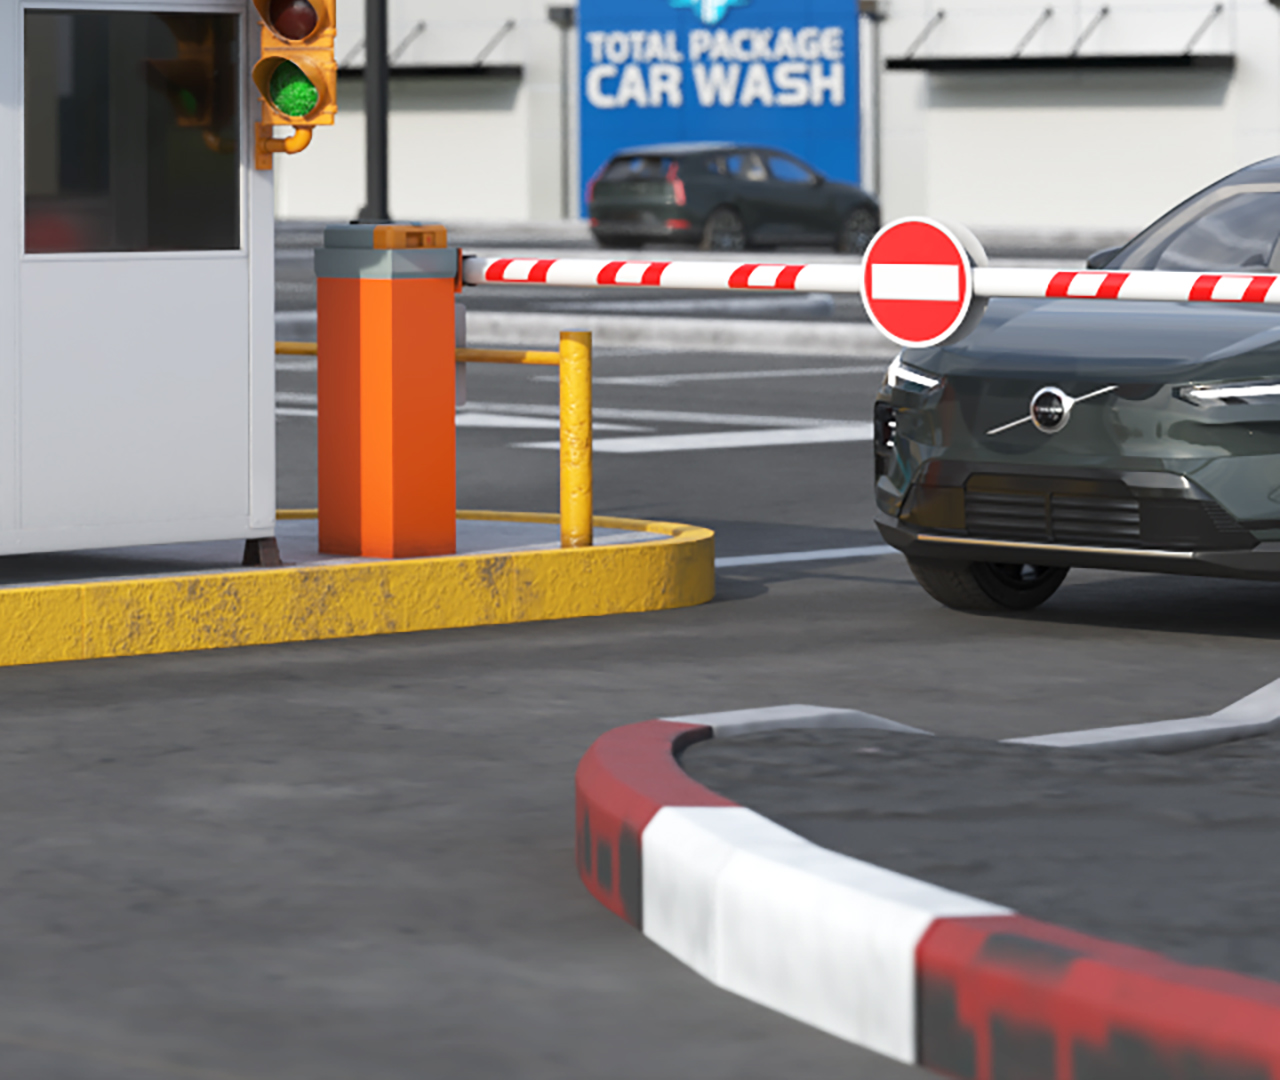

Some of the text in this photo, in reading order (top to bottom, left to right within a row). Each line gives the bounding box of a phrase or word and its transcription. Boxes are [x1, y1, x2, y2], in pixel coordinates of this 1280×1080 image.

[585, 26, 844, 64] TOTAL PACKAGE
[585, 61, 845, 109] CAR WASH
